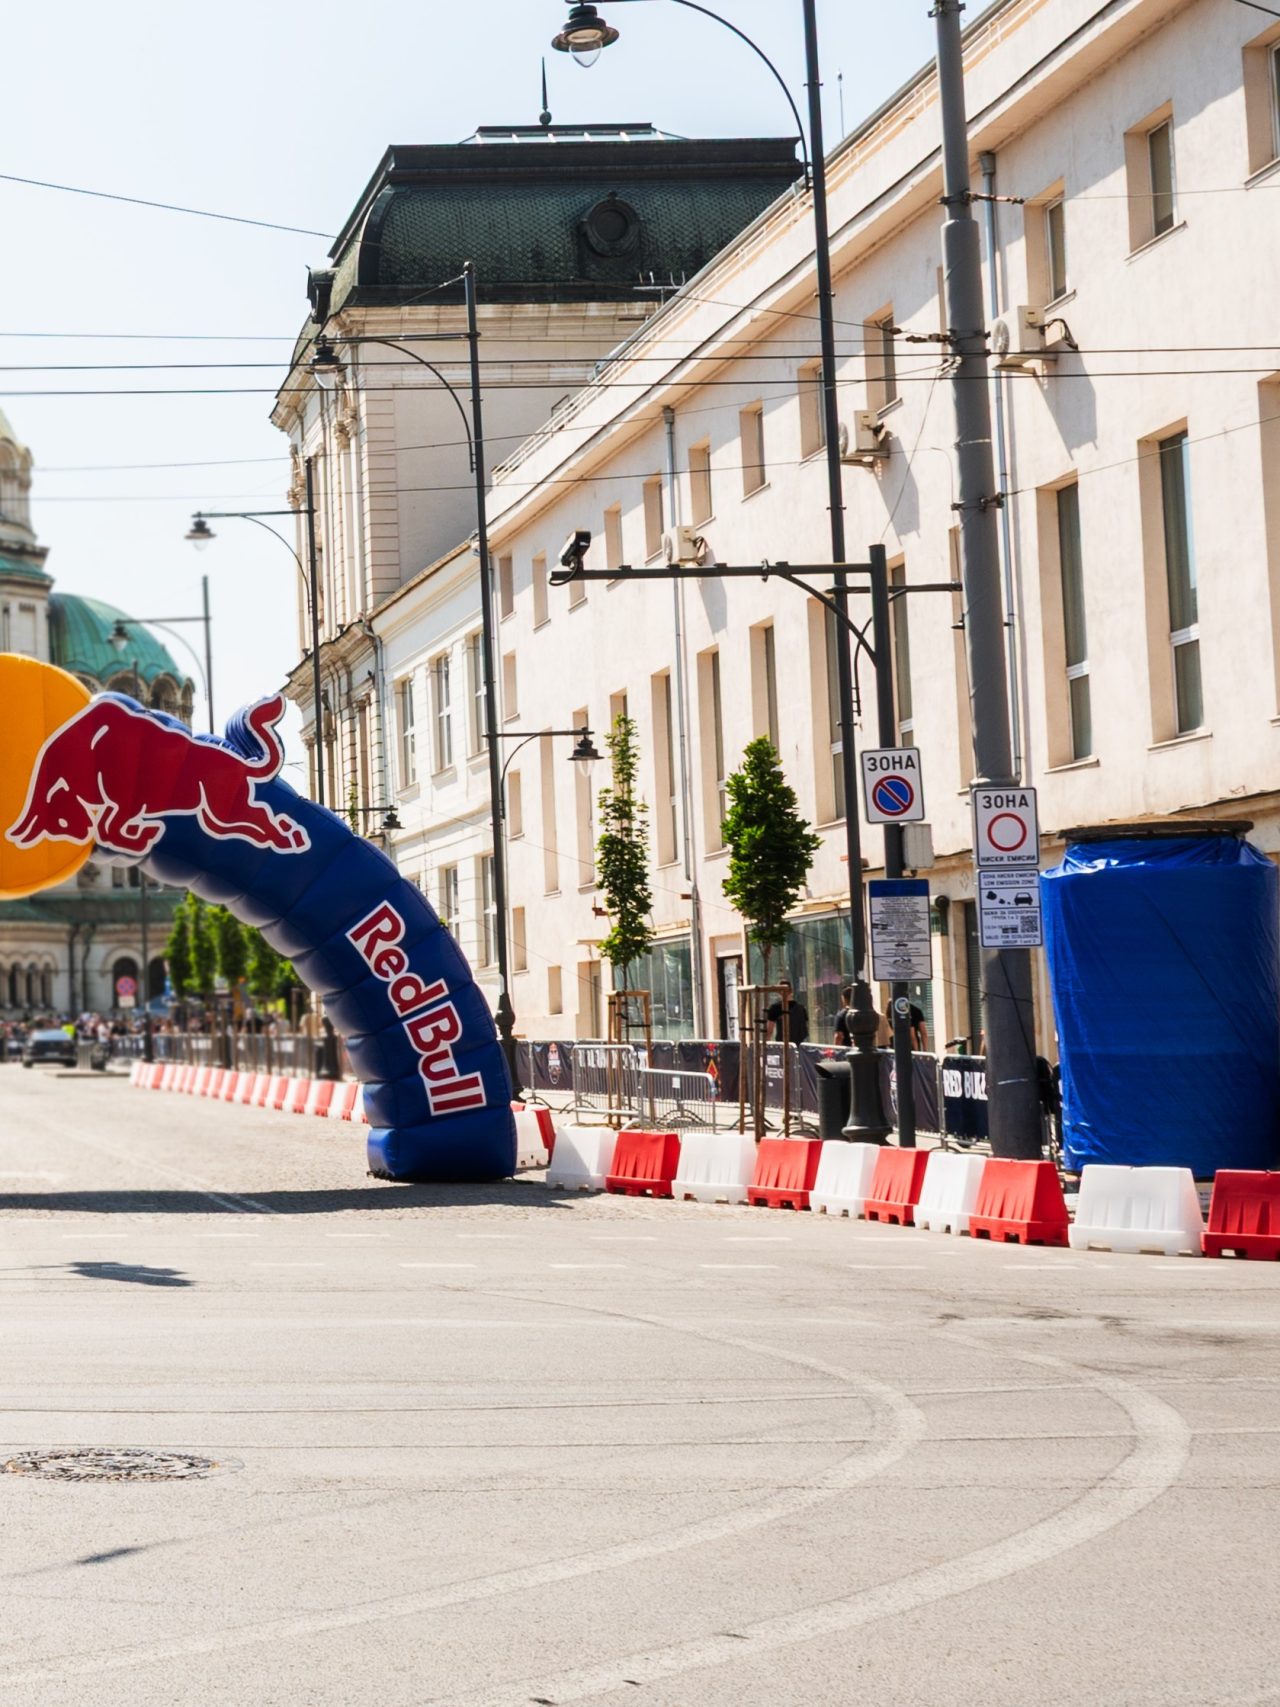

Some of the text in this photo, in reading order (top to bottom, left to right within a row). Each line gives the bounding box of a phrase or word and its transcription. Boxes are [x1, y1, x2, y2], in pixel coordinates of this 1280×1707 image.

[867, 754, 916, 772] ЗОНА
[982, 794, 1030, 810] ЗОНА
[943, 1069, 989, 1101] RED BULL
